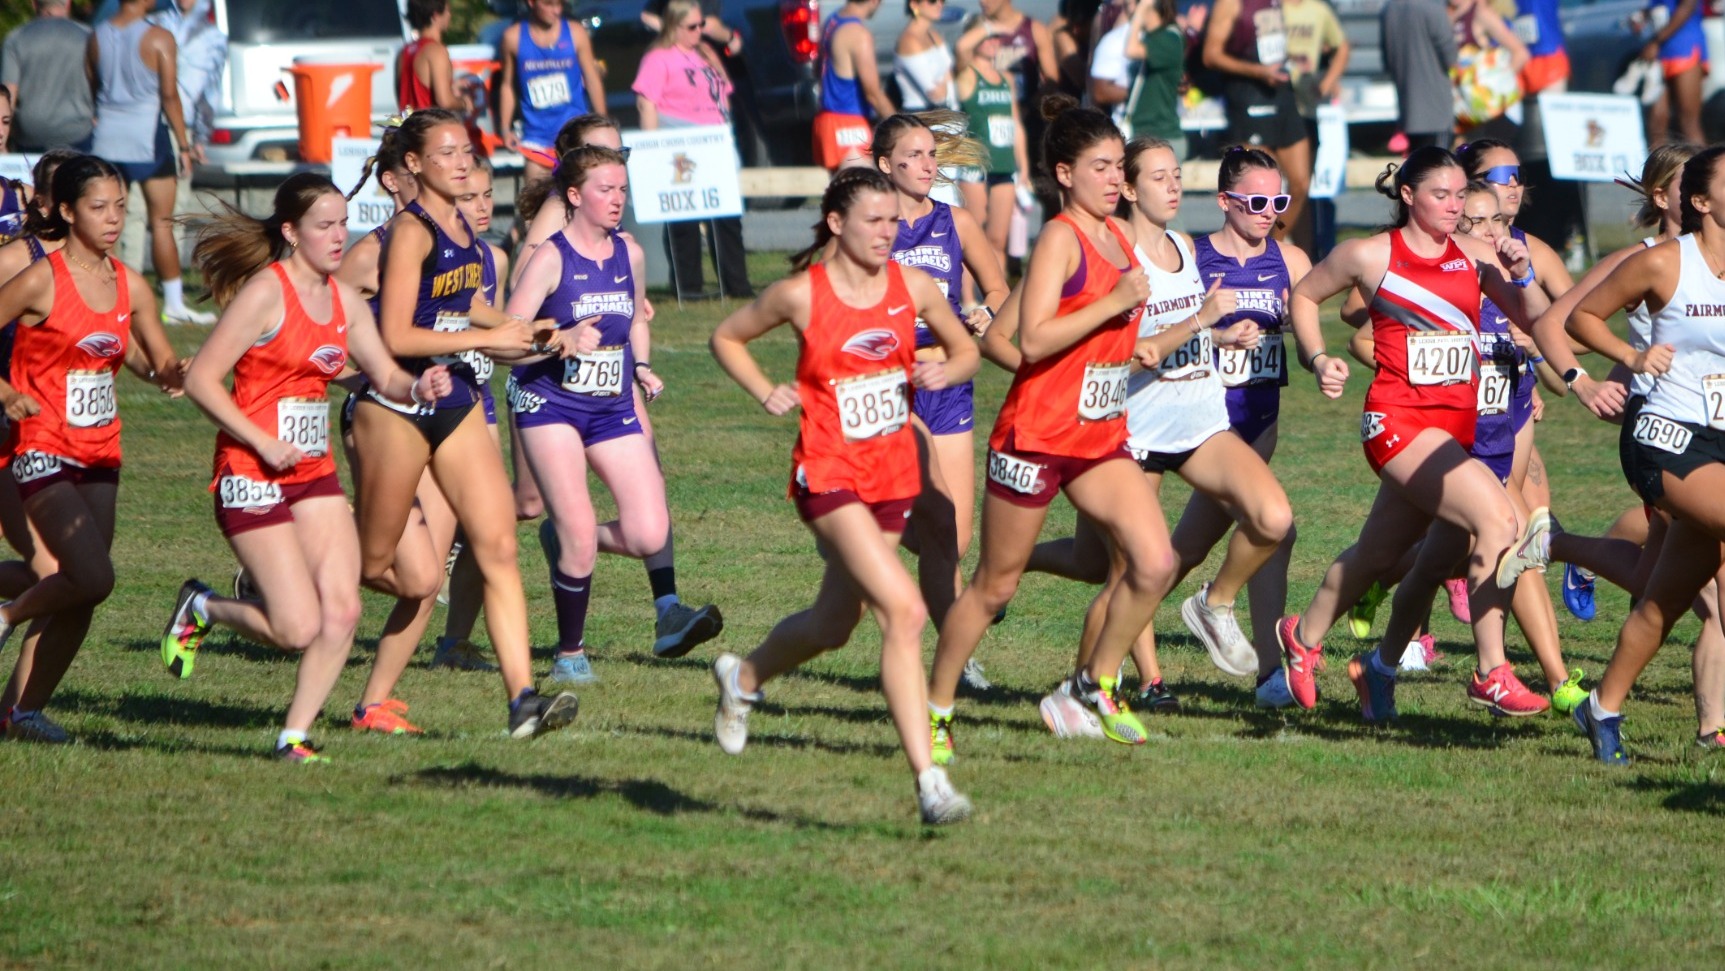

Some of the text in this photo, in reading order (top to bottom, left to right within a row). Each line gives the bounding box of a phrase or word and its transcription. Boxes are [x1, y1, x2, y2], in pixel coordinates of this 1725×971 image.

[657, 187, 720, 213] BOX 16
[894, 247, 940, 261] SAINT
[431, 266, 464, 299] WEST
[1236, 291, 1271, 301] AINT
[582, 292, 627, 303] SAINT
[1146, 294, 1197, 317] FAIRMONT
[1685, 304, 1725, 317] FAIRM
[566, 358, 620, 387] 3769
[1413, 346, 1470, 376] 4207
[844, 382, 908, 428] 3852
[1084, 377, 1128, 408] 3846
[283, 415, 327, 445] 3854
[1637, 416, 1688, 449] 2690
[991, 452, 1034, 488] 3846
[225, 479, 276, 503] 3854
